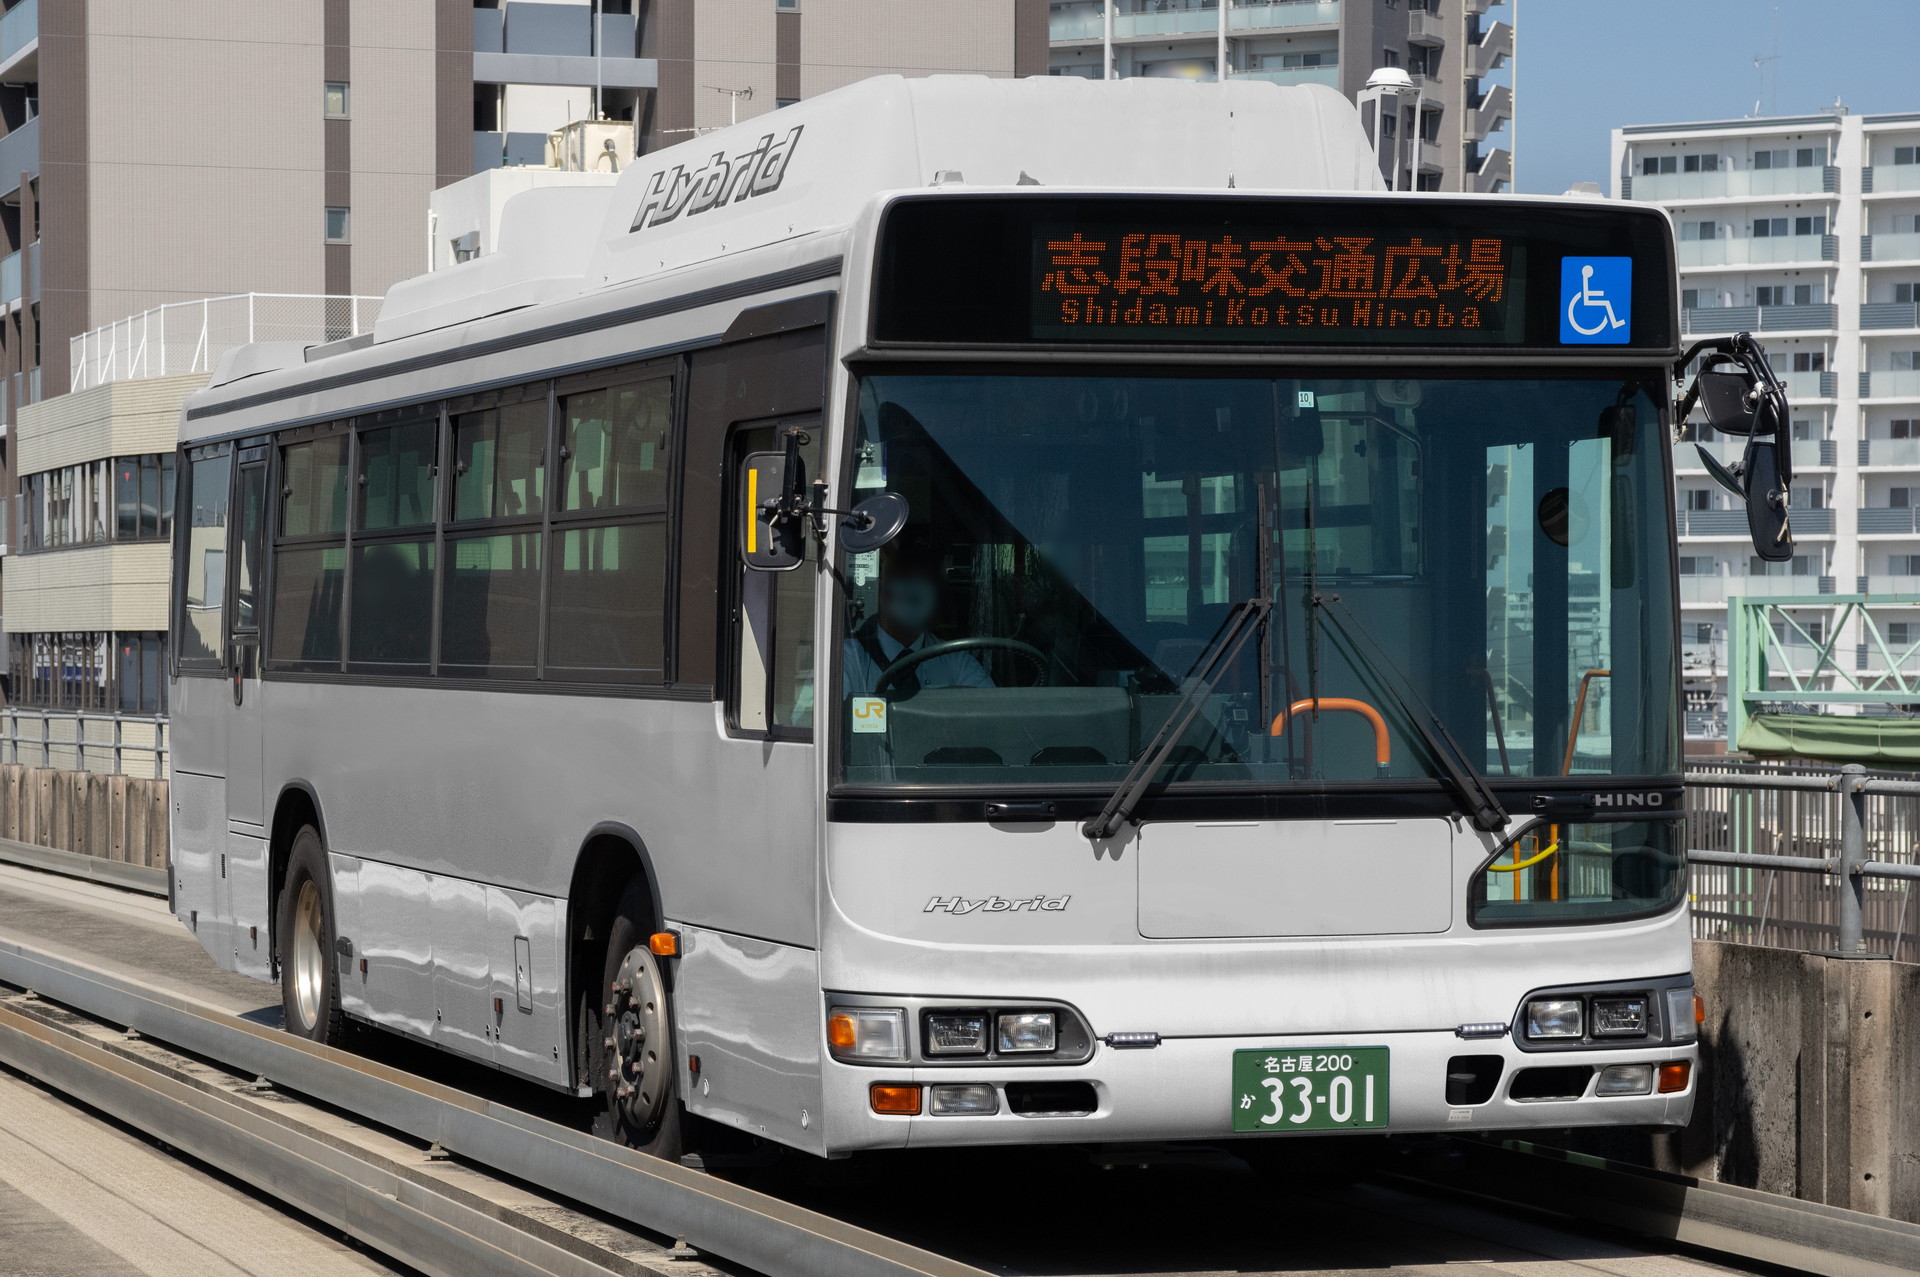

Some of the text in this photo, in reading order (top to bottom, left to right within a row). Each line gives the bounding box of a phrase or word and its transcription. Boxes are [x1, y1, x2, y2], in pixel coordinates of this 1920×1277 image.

[629, 124, 804, 233] Hybrid
[1042, 233, 1504, 301] 志段味交通広場
[1061, 297, 1481, 327] Shidami Kotsu Hiroba
[854, 701, 885, 719] JR
[1595, 792, 1663, 807] HINO
[923, 894, 1072, 915] Hybrid
[1260, 1074, 1375, 1125] 33-01
